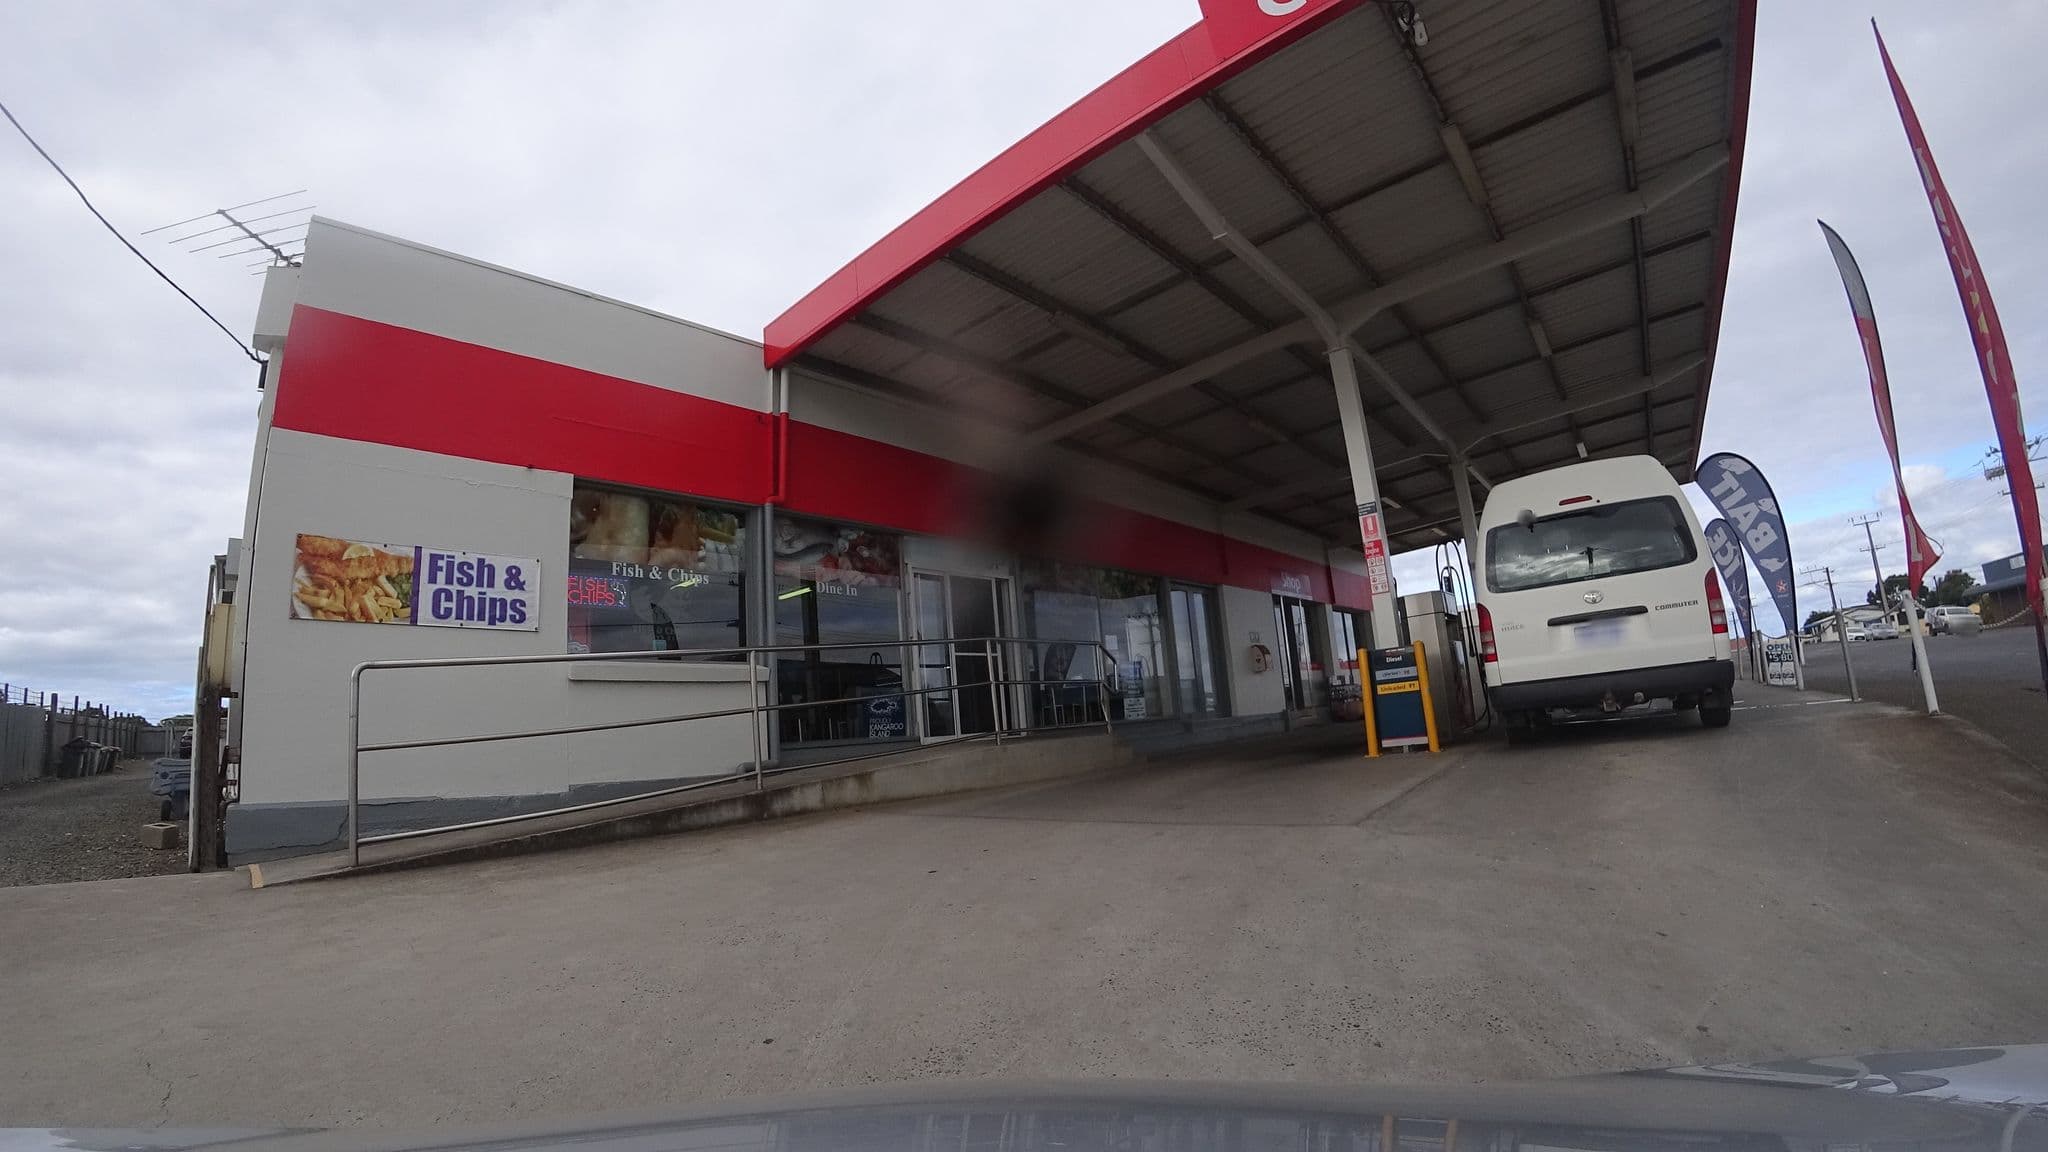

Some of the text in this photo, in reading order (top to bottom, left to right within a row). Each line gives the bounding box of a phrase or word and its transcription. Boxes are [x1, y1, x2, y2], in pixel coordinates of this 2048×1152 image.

[427, 551, 527, 592] Fish &
[611, 562, 709, 586] Fish & Chips
[568, 577, 608, 592] FISH
[816, 580, 858, 598] Dine In
[568, 589, 616, 606] CHIPS
[1654, 599, 1699, 611] COMMUTER
[431, 587, 527, 626] Chips
[1385, 655, 1402, 663] Diesel
[870, 722, 904, 730] KANGAROO
